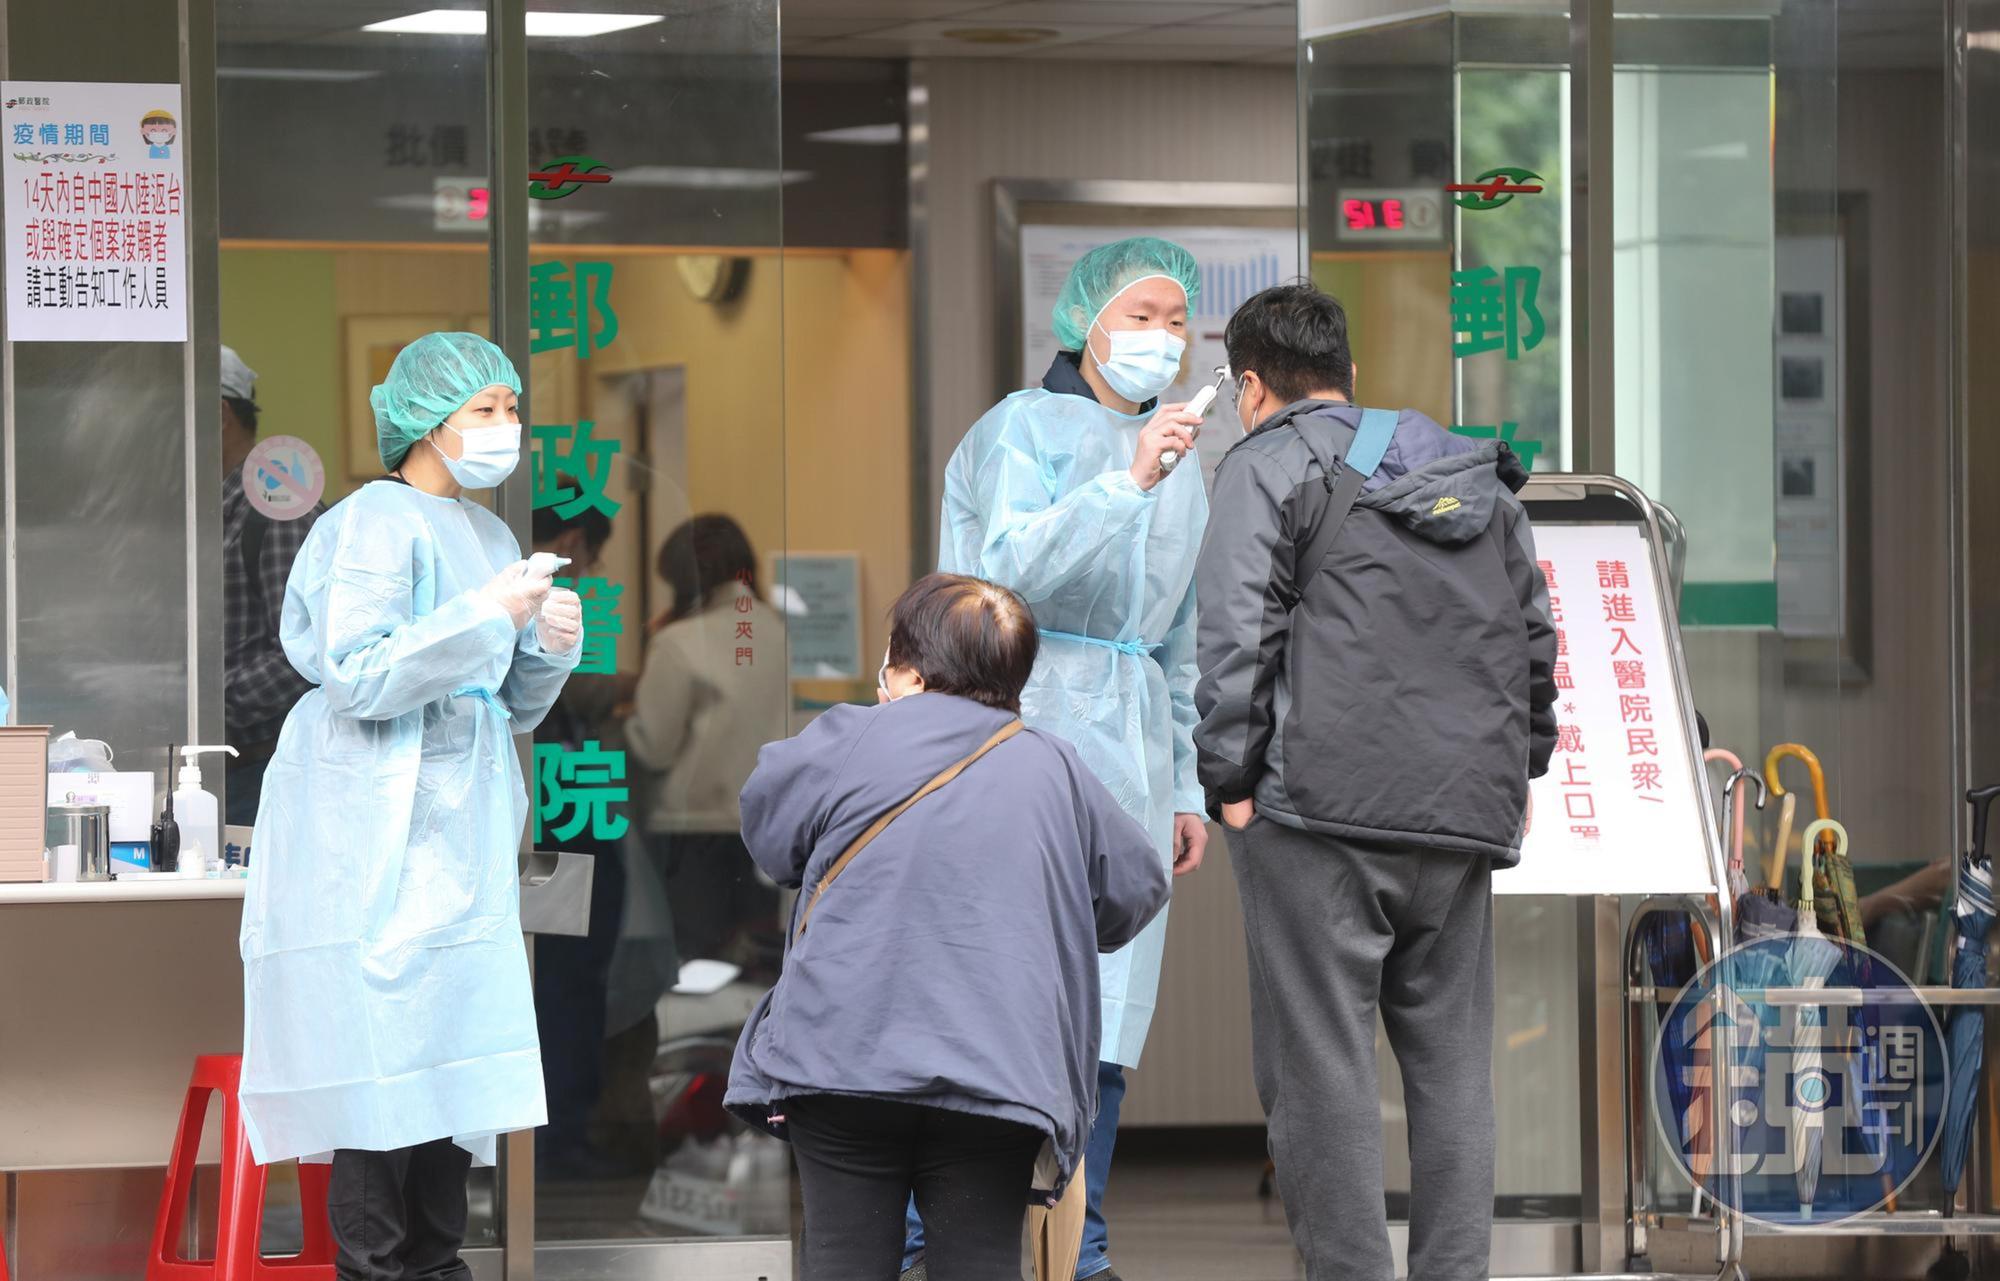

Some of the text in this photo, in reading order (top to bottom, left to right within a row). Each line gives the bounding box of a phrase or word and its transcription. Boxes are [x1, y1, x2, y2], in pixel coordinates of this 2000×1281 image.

[13, 122, 110, 146] 疫情期間
[24, 171, 181, 216] 14天內自中國大陸返台
[26, 217, 167, 262] 或與確定個案接觸者
[27, 265, 169, 309] 請主動告知工作人員
[133, 847, 145, 860] M
